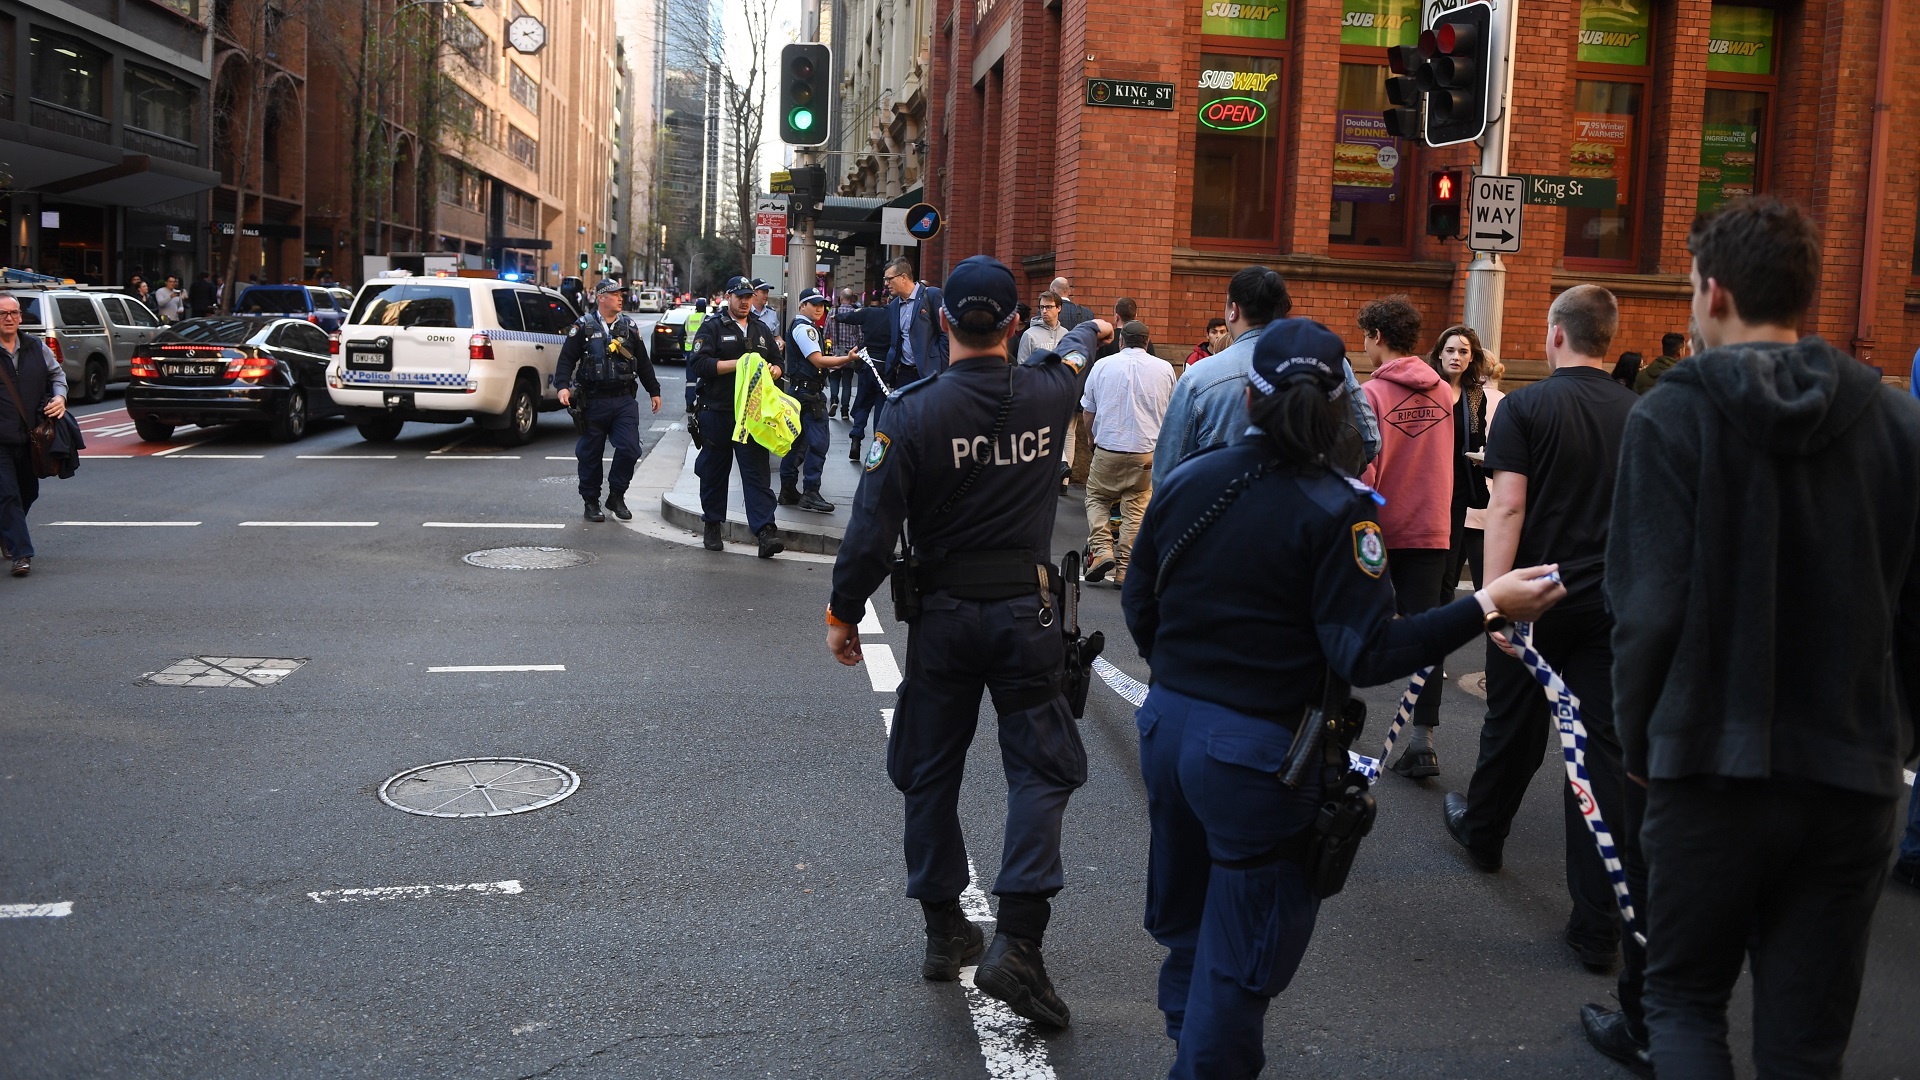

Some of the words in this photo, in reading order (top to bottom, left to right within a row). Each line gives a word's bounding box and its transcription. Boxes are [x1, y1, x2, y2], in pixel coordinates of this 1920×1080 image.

[1206, 2, 1279, 21] SUBWAY
[1341, 12, 1412, 29] SUBWAY
[1198, 69, 1278, 92] SUBWAY
[1115, 84, 1148, 98] KING
[1155, 87, 1172, 99] ST
[1208, 103, 1257, 122] OPEN
[1346, 119, 1372, 127] Double
[1600, 122, 1625, 131] Winter
[1588, 130, 1624, 139] WARMERS
[1704, 135, 1746, 143] INGREDIENTS
[1480, 183, 1515, 201] ONE
[1534, 178, 1566, 198] King
[1569, 180, 1584, 195] St
[1476, 206, 1516, 224] WAY
[184, 365, 196, 374] BK
[1290, 357, 1319, 366] POLICE
[358, 371, 391, 380] Police
[952, 426, 1050, 469] POLICE
